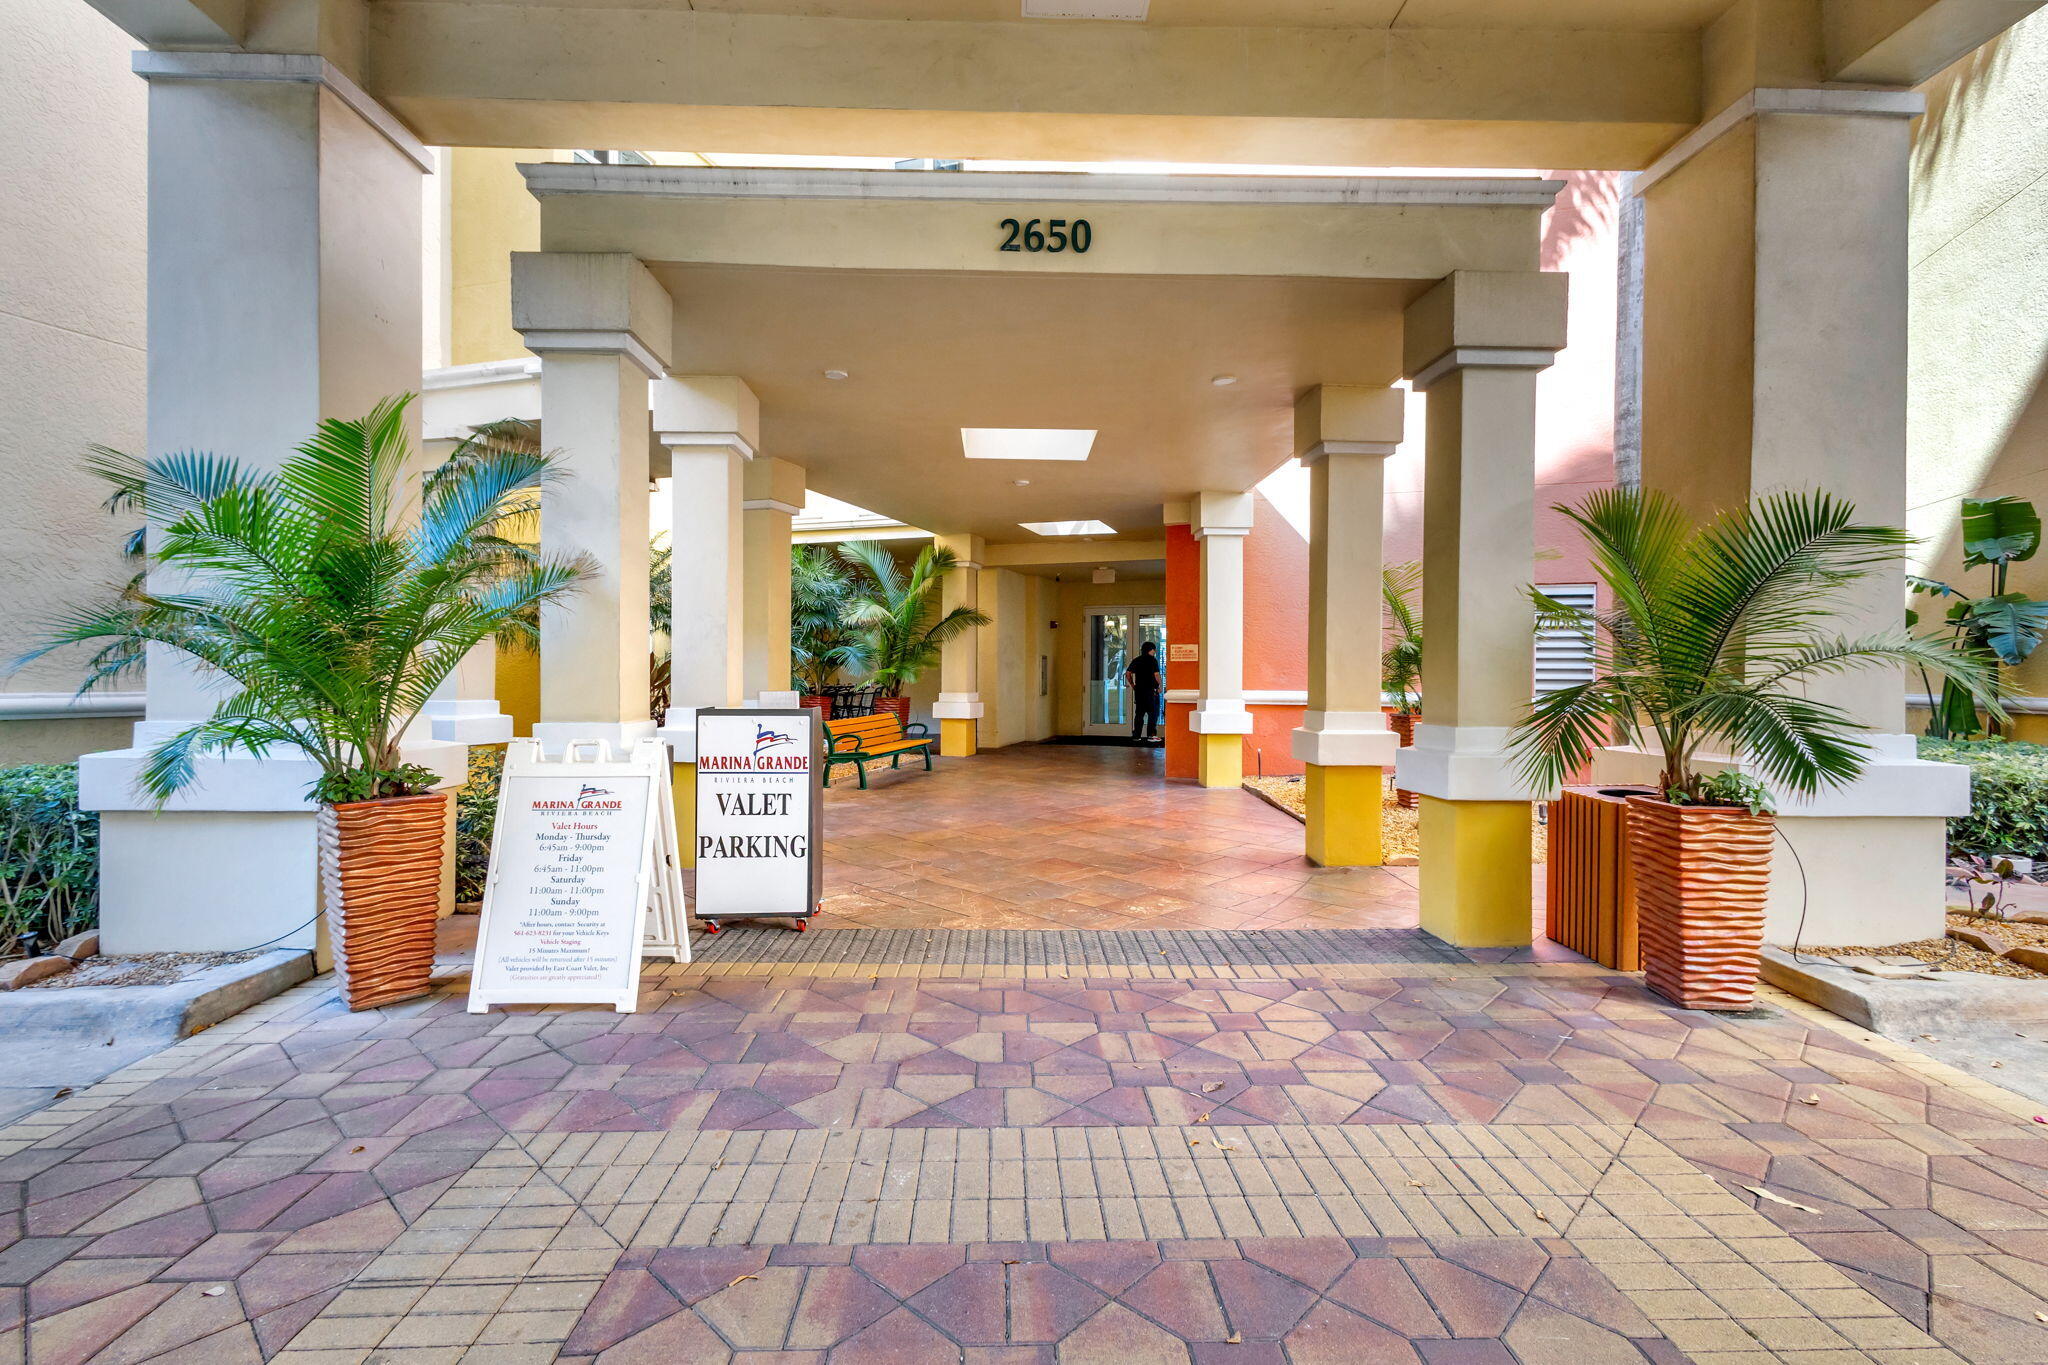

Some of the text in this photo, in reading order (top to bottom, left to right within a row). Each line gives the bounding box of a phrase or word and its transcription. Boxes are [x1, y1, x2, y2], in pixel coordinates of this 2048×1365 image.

[1000, 219, 1092, 253] 2650
[699, 756, 808, 770] MARINA GRANDE
[716, 793, 792, 816] VALET
[552, 822, 598, 830] Valet Hours
[536, 833, 568, 842] Monday
[576, 833, 611, 842] Thursday
[575, 844, 604, 852] 9:00pm
[698, 835, 806, 858] PARKING
[558, 854, 584, 863] Friday
[534, 864, 562, 872] 6:45am
[570, 864, 604, 874] 11:00pm
[550, 876, 586, 884] Saturday
[529, 886, 562, 894] 11:00am
[570, 886, 604, 896] 11:00pm
[550, 897, 580, 906] Sunday
[570, 909, 600, 918] 9:00pm
